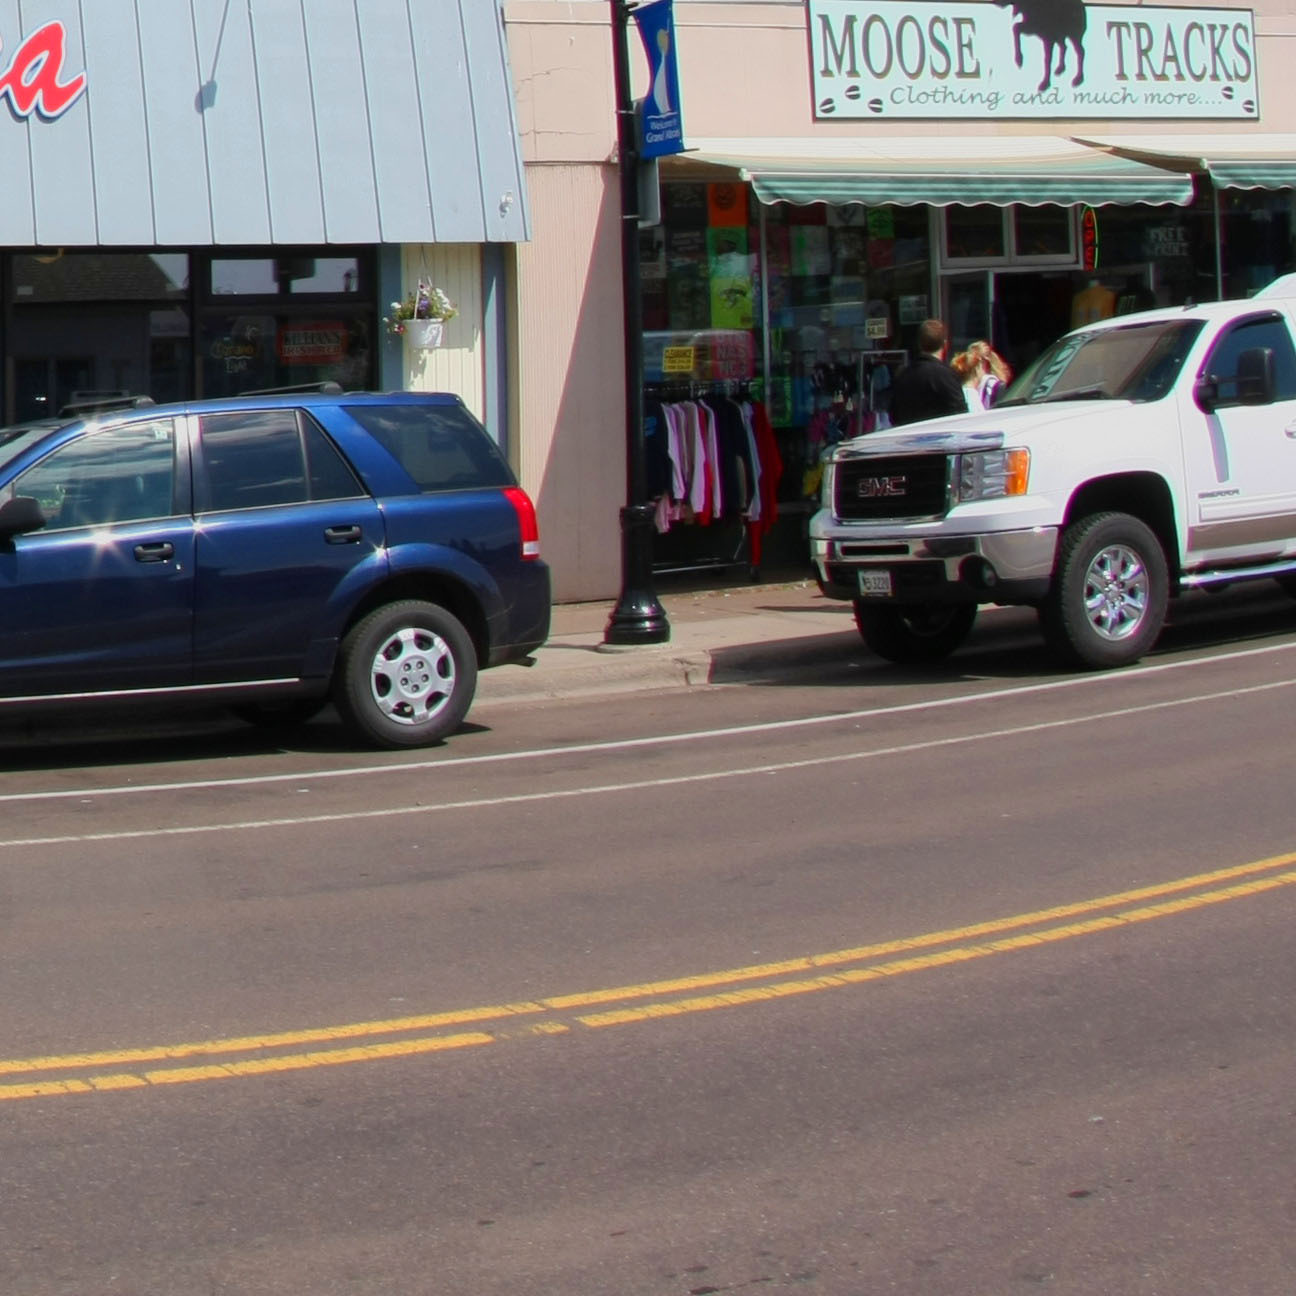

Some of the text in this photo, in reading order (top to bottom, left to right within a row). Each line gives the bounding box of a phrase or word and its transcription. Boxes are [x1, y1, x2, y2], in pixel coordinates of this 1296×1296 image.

[817, 14, 1252, 83] MOOSE TRACKS
[890, 86, 1003, 110] Clothing
[1012, 87, 1063, 105] and
[1073, 87, 1137, 105] much
[859, 476, 906, 497] GMC
